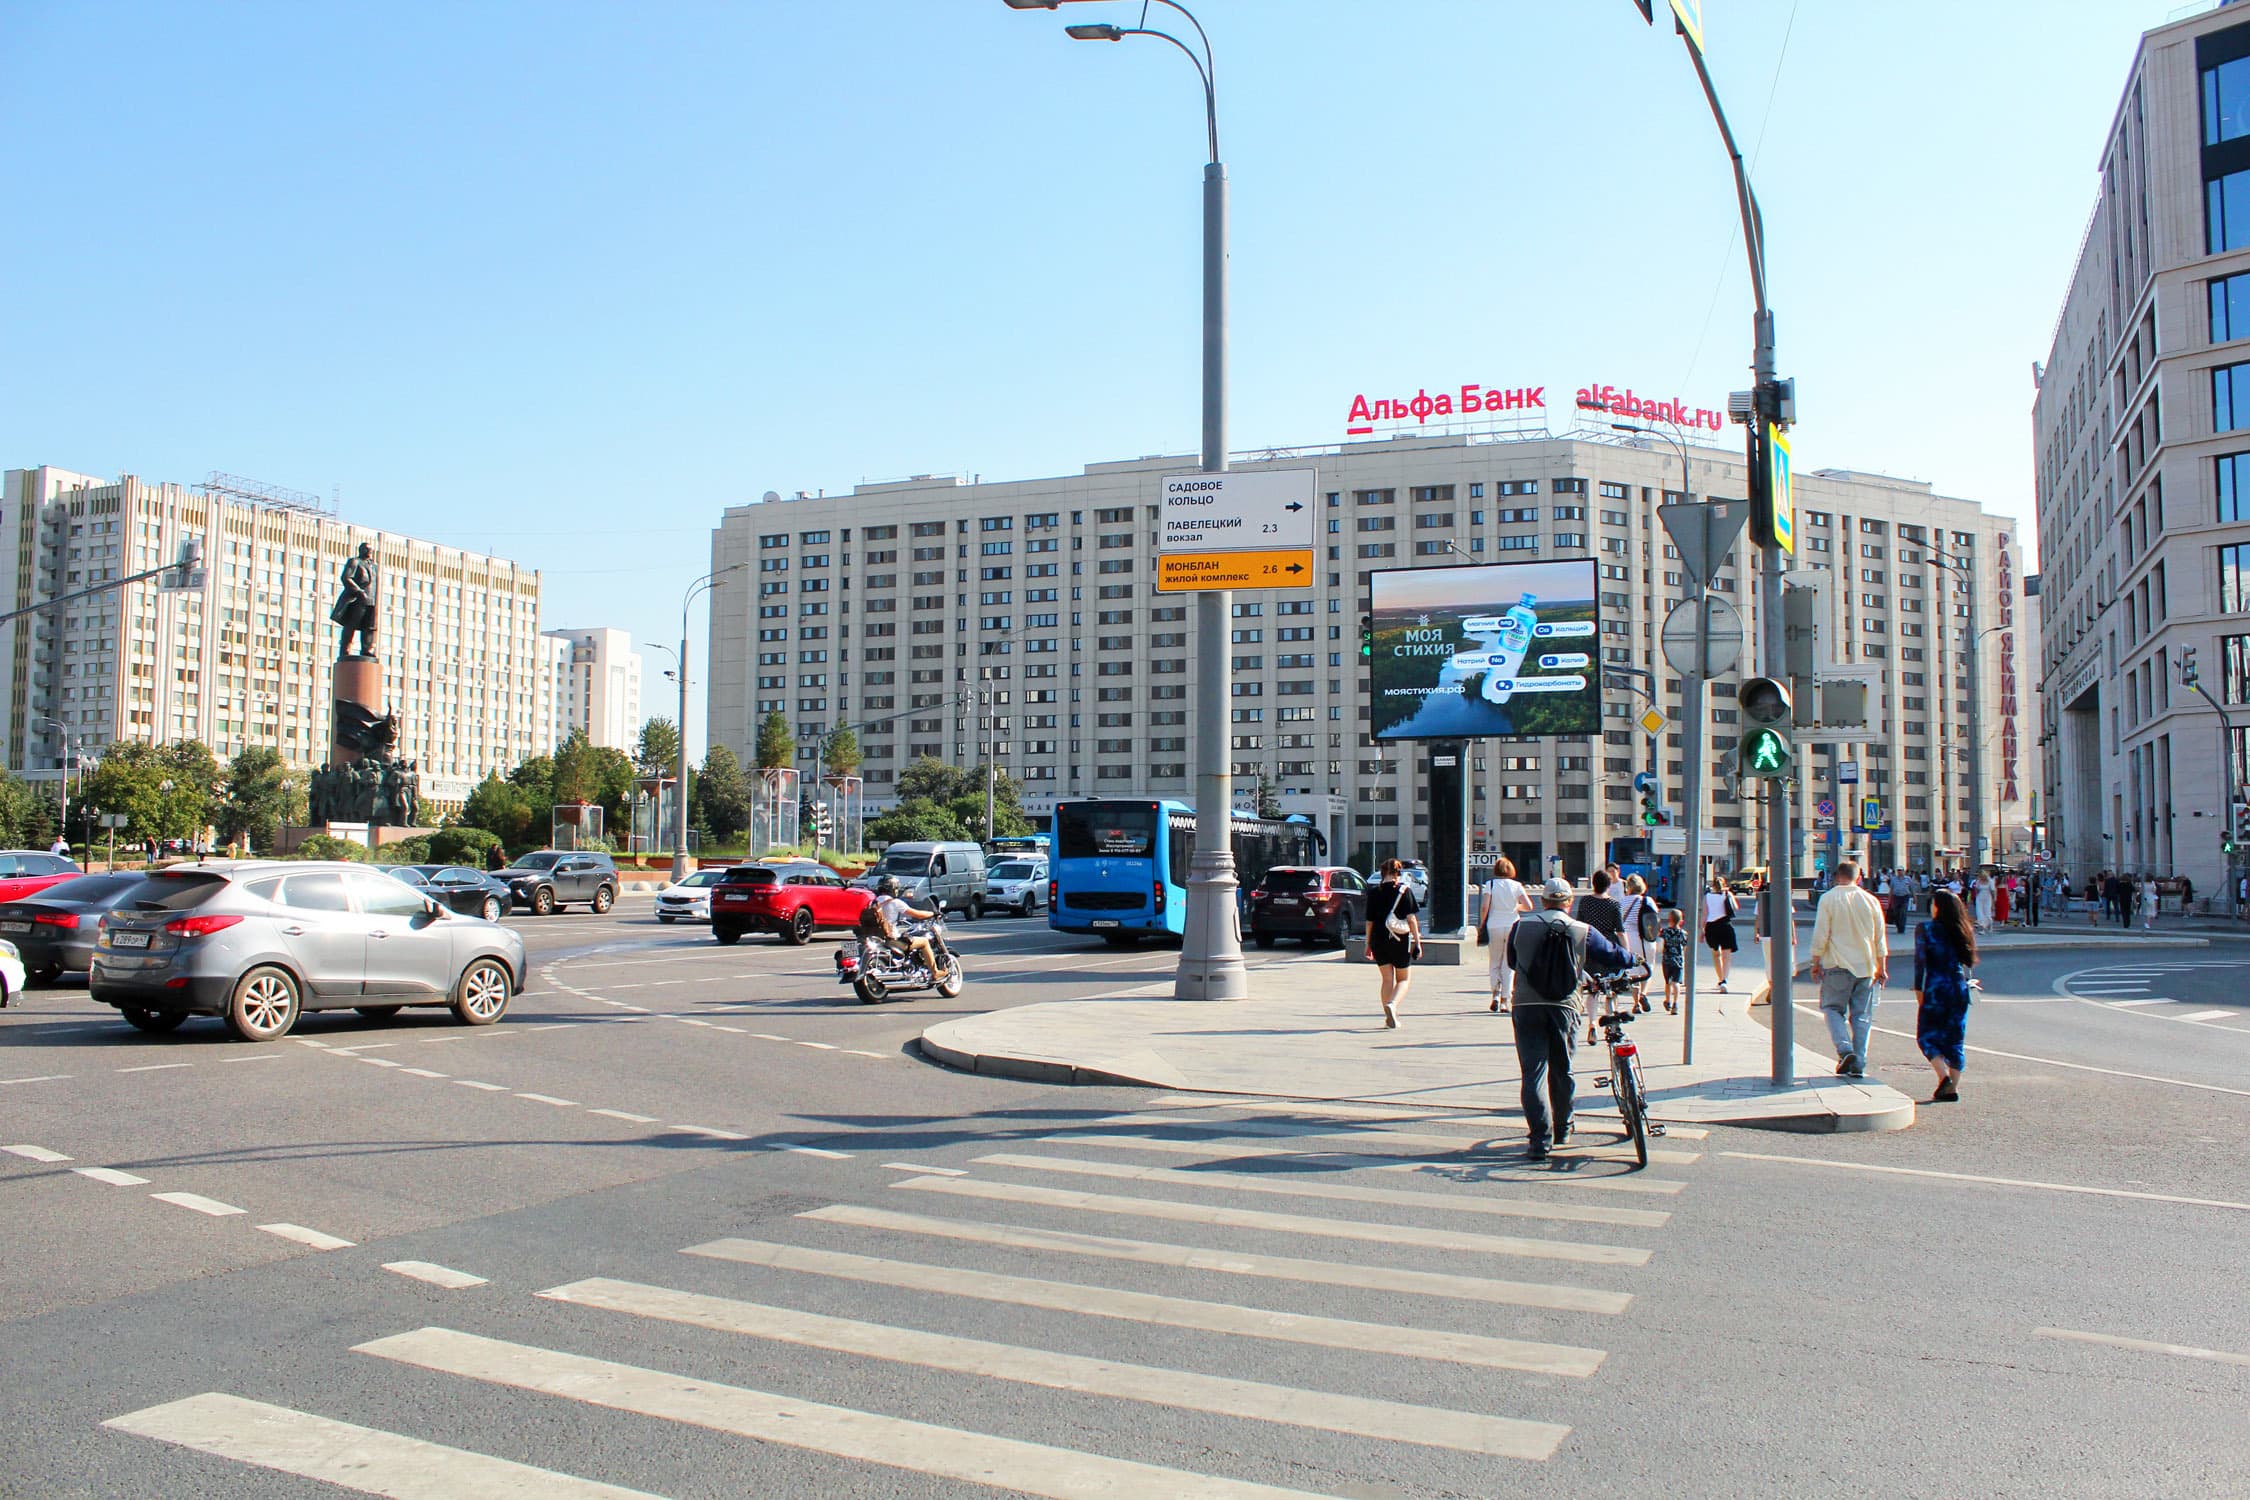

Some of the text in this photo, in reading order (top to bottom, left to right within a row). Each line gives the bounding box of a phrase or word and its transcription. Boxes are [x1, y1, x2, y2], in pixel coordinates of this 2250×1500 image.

[1347, 384, 1545, 424] Альфа Банк
[1576, 384, 1721, 430] alfabank.ru
[1168, 481, 1223, 493] САДОВОЕ
[1168, 495, 1214, 506] КОЛЬЦО
[1167, 517, 1278, 533] ПАВЕЛЕЦКИЙ 2.3
[1167, 534, 1203, 542] вокзал
[1166, 561, 1278, 573] МОНБЛАН 2.6
[1165, 573, 1249, 583] жилой комплекс
[1405, 629, 1442, 642] МОЯ
[1394, 644, 1455, 656] СТИХИЯ
[1998, 532, 2019, 801] РАЙОН ЯКИМАНКА
[1384, 686, 1466, 696] моястихия.рф
[1469, 854, 1498, 865] ТОП
